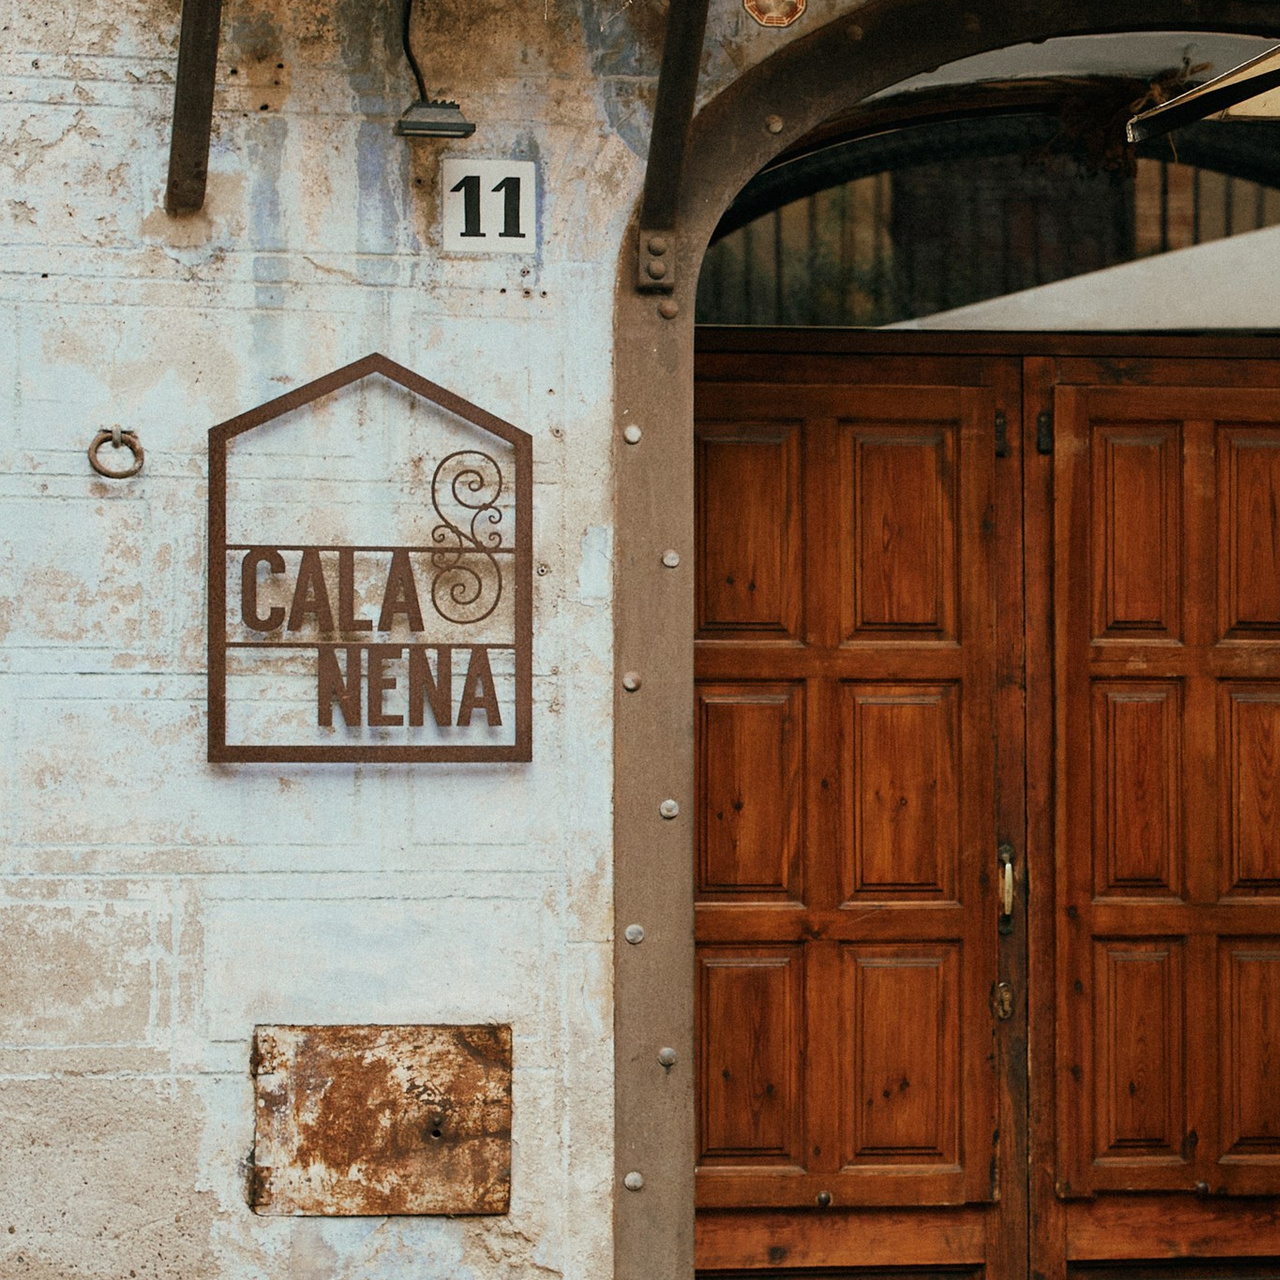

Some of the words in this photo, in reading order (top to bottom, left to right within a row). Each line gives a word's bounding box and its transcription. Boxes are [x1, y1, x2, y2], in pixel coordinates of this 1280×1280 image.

[450, 175, 526, 238] 11
[241, 549, 425, 632] CALA
[317, 646, 503, 727] NENA
